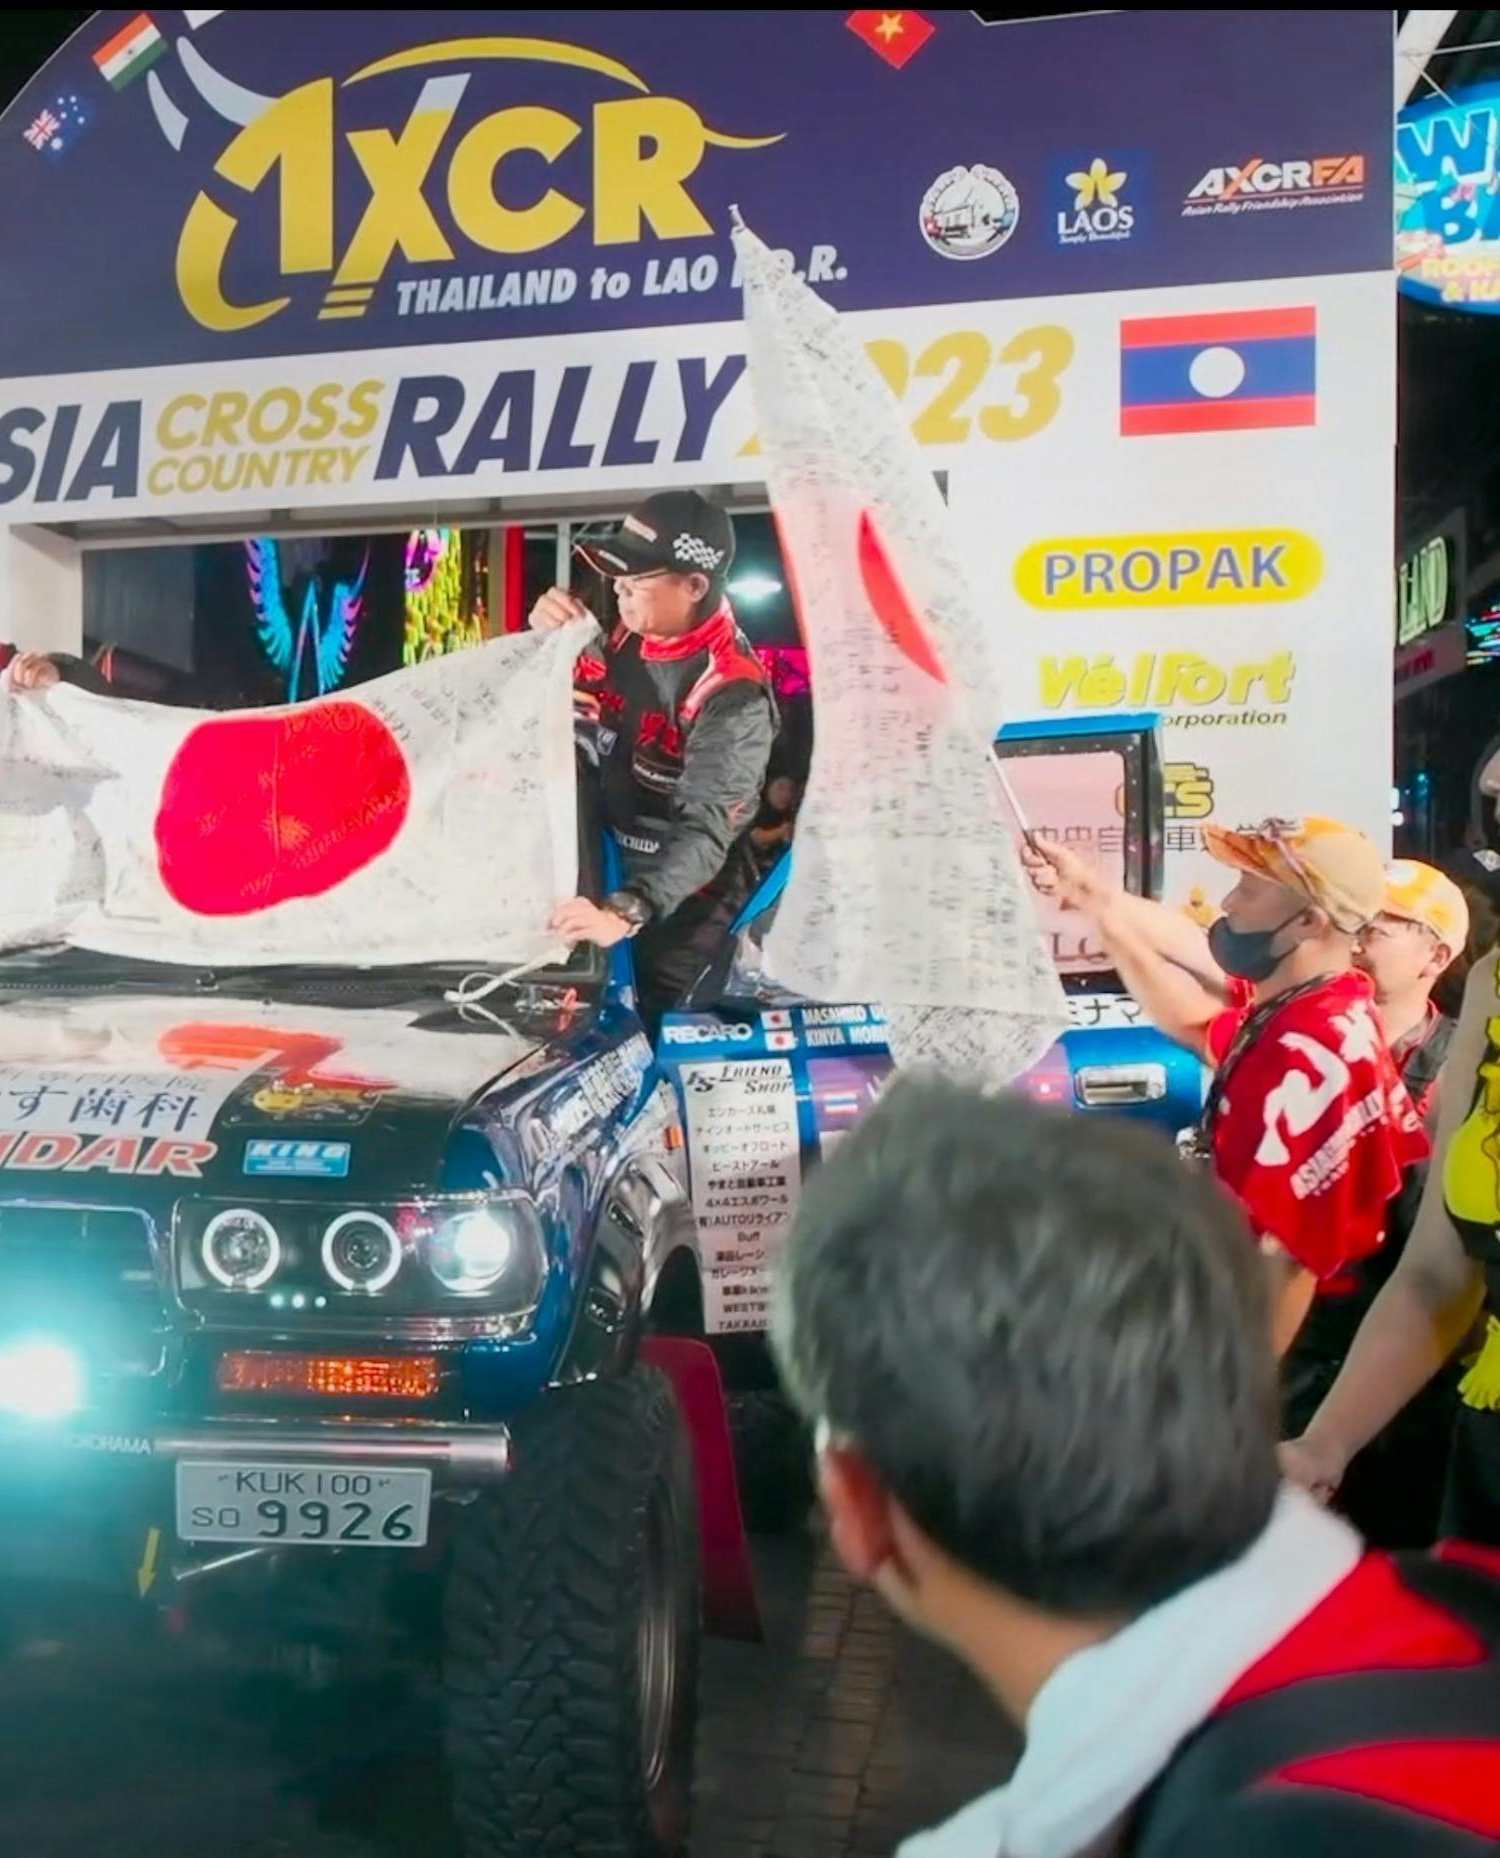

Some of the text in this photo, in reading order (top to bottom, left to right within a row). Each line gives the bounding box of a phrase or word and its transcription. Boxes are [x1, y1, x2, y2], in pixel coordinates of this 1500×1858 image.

[1188, 155, 1364, 200] AXCRFA
[1057, 205, 1135, 235] LAOS
[397, 267, 577, 316] THAILAND
[591, 266, 631, 300] to
[643, 254, 719, 296] LAO
[155, 379, 385, 452] CROSS
[373, 352, 750, 482] RALLY
[147, 445, 372, 496] COUNTRY
[1045, 543, 1290, 597] PROPAK
[1161, 709, 1288, 730] orporation
[662, 1022, 753, 1044] RECARO
[237, 1471, 371, 1495] KUK 100
[192, 1500, 413, 1541] SO 9926
